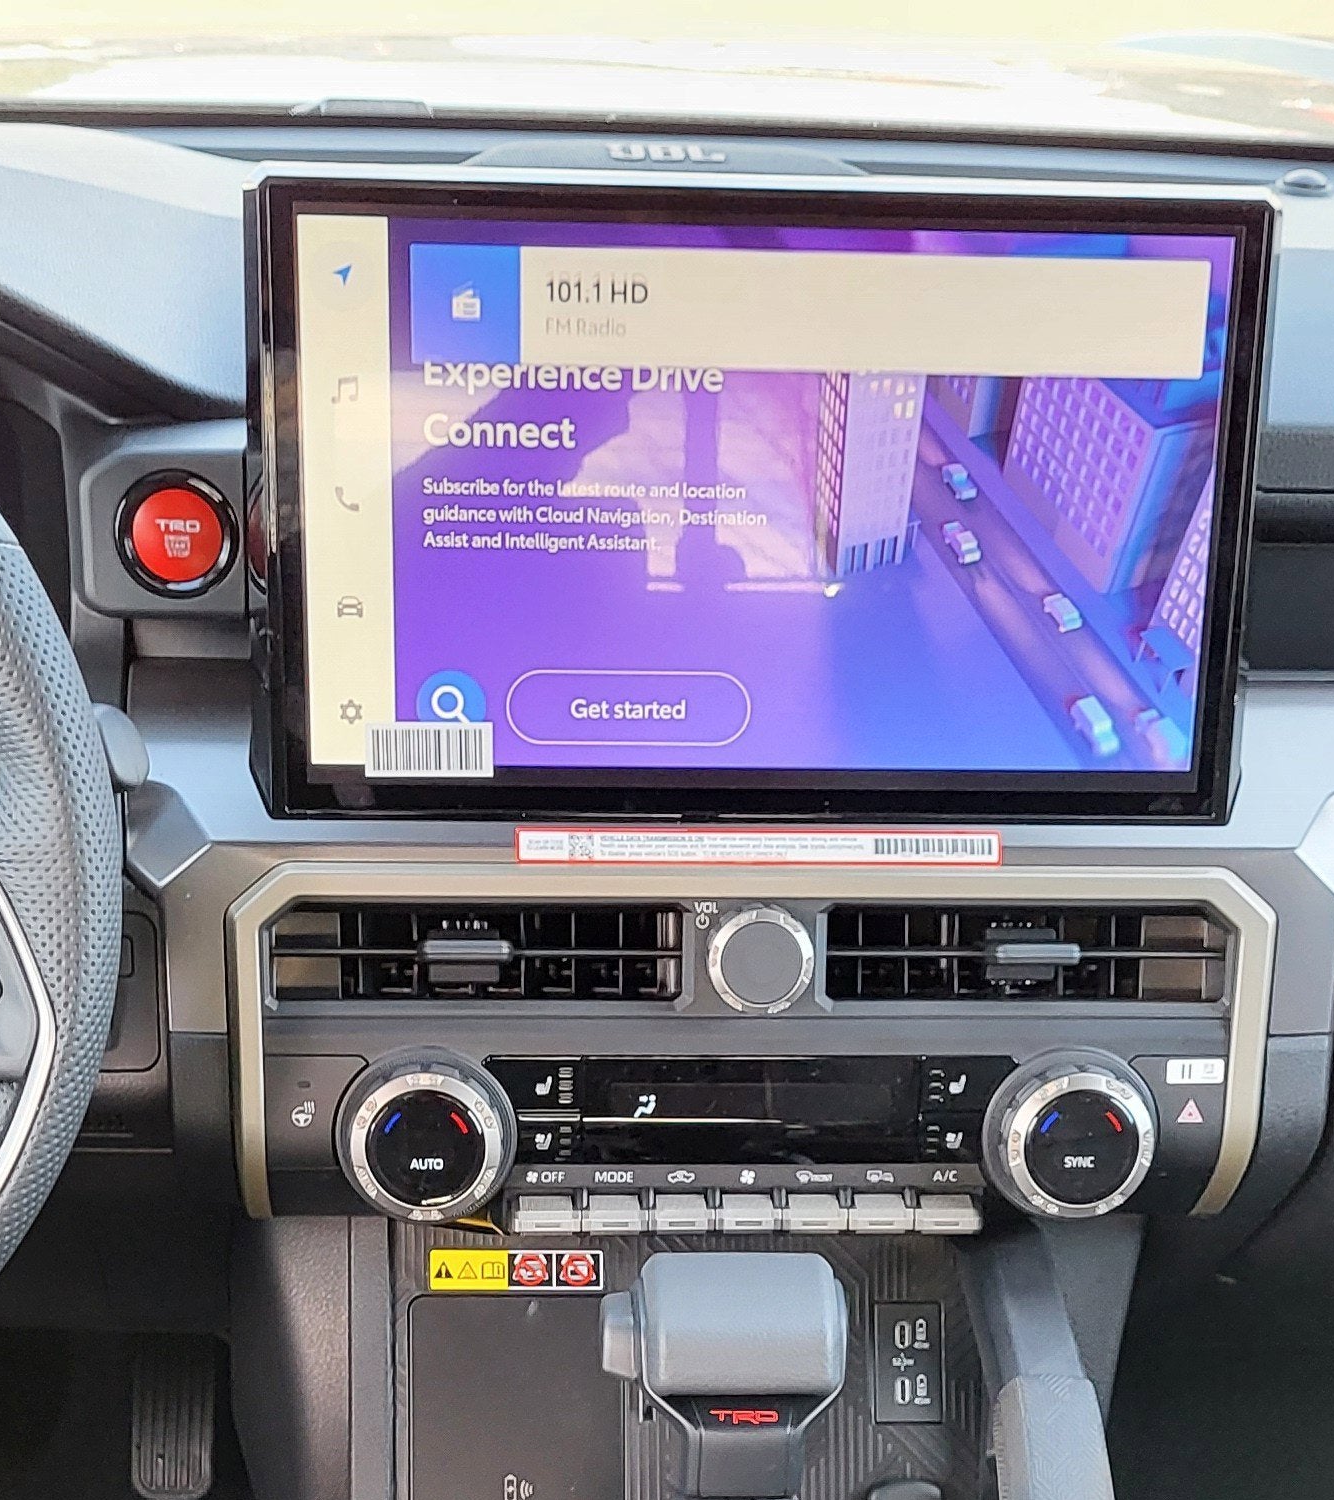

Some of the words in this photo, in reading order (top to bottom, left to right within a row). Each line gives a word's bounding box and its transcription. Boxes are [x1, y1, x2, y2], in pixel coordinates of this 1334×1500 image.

[545, 279, 602, 303] 101.1
[610, 282, 648, 305] HD
[546, 318, 571, 336] FM
[576, 318, 626, 337] Radio
[424, 361, 623, 395] Experience
[631, 365, 724, 392] Drive
[423, 412, 576, 449] Connect
[422, 477, 499, 497] Subscribe
[502, 478, 526, 496] for
[527, 478, 554, 497] the
[557, 479, 600, 498] latest
[603, 483, 646, 498] route
[649, 482, 679, 499] and
[682, 482, 746, 500] location
[422, 505, 496, 525] guidance
[498, 505, 534, 523] with
[535, 505, 584, 524] Cloud
[587, 507, 675, 528] Navigation,
[679, 509, 767, 527] Destination
[154, 519, 201, 533] TRD
[422, 531, 469, 549] Assist
[471, 532, 502, 550] and
[505, 532, 584, 553] Intelligent
[586, 533, 662, 552] Assistant.
[570, 698, 610, 720] Get
[613, 698, 687, 720] started
[694, 901, 719, 914] VOL
[409, 1157, 444, 1171] AUTO
[1063, 1155, 1096, 1169] SYNC
[540, 1171, 566, 1183] OFF
[594, 1171, 634, 1183] MODE
[932, 1169, 959, 1184] A/C
[709, 1410, 779, 1425] TRD
